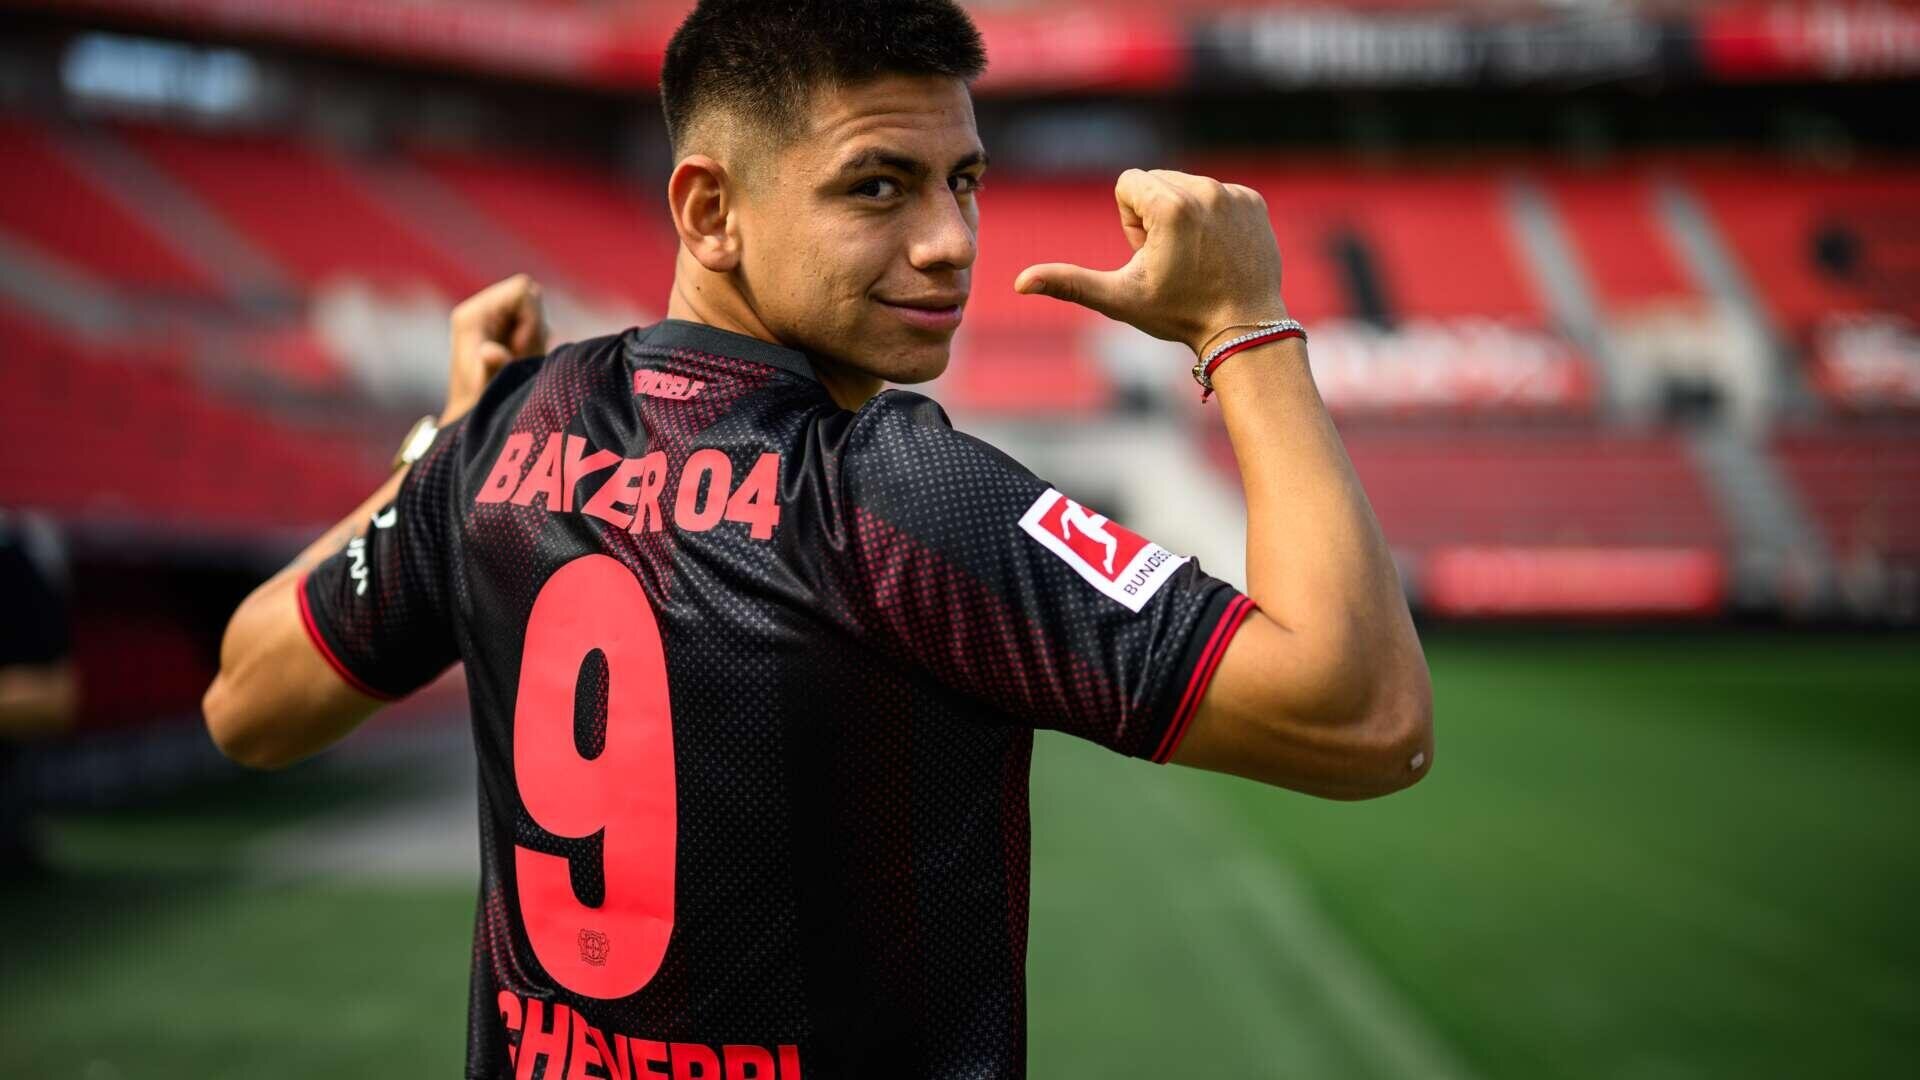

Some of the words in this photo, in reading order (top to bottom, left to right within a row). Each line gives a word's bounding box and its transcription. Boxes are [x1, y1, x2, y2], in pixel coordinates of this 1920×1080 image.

[475, 432, 668, 535] BAYER
[673, 448, 781, 540] 04
[1123, 549, 1172, 596] BUNDES
[513, 553, 677, 1000] 9
